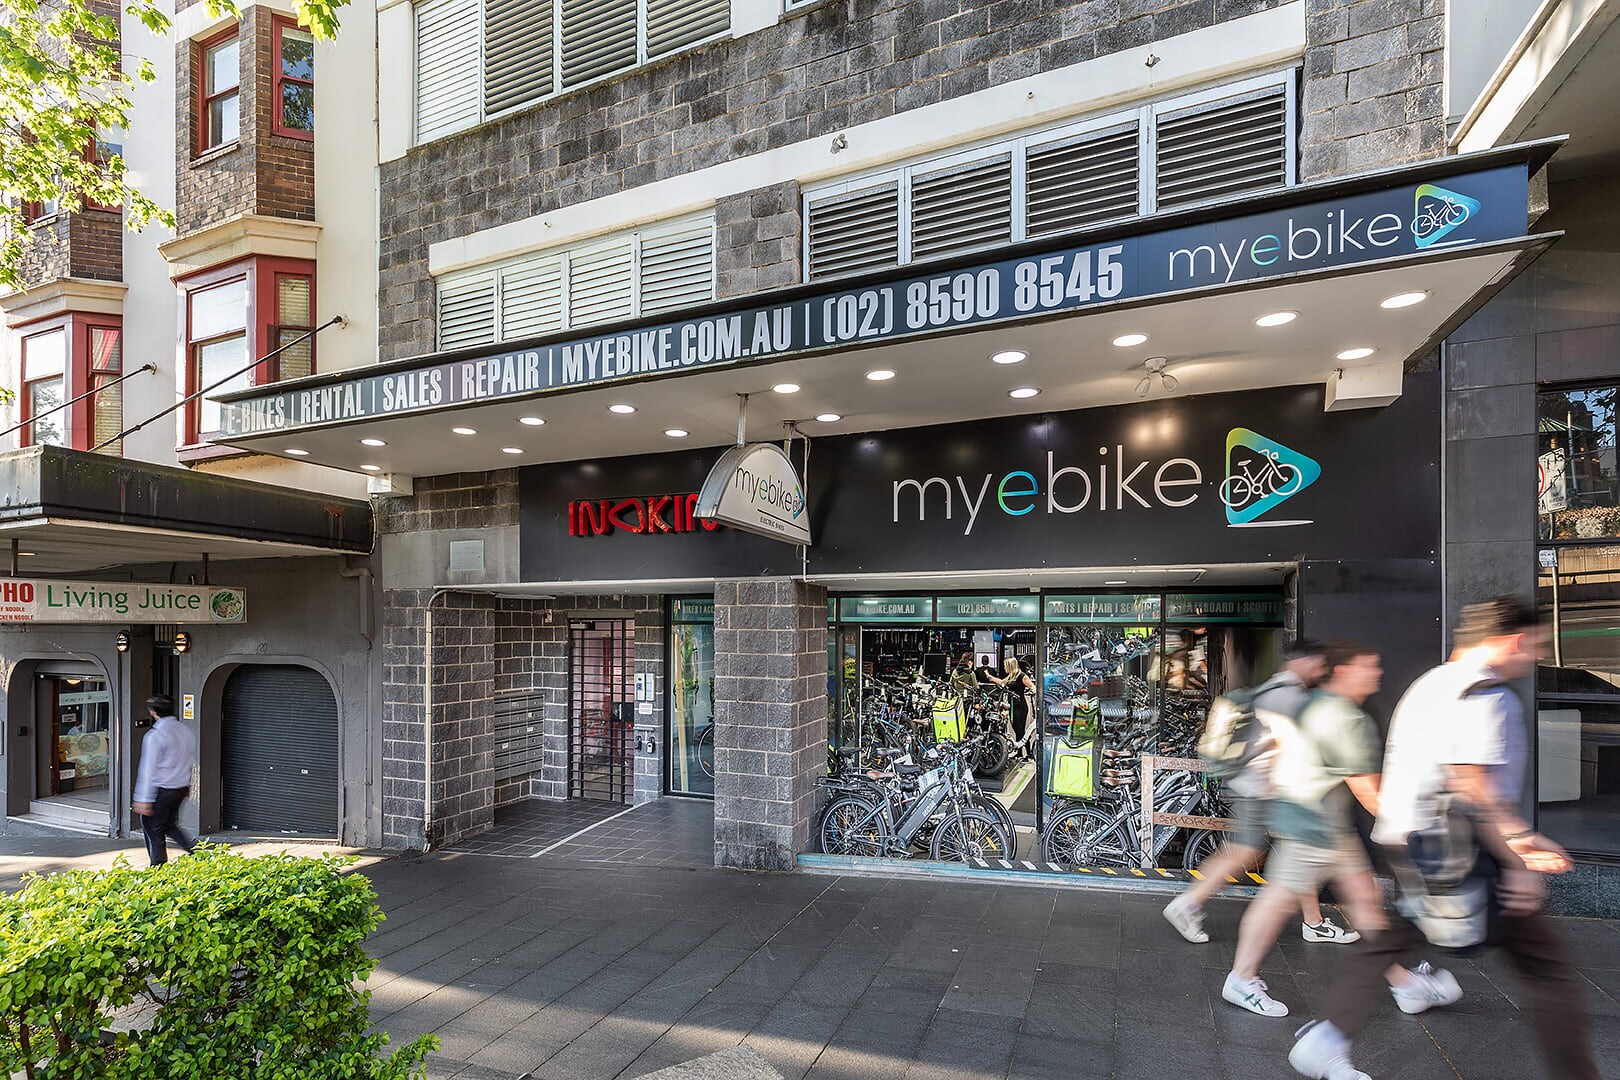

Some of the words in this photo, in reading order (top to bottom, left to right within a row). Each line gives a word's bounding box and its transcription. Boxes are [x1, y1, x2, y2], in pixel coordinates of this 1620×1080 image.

[1169, 209, 1402, 283] myebike
[226, 395, 285, 434] E-BIKES
[300, 383, 365, 424] RENTAL
[382, 368, 442, 412] SALES
[462, 348, 539, 400] REPAIR
[562, 307, 792, 384] MYEBIKE.COM.AU
[823, 287, 893, 343] (02)
[906, 268, 1000, 329] 8590
[1014, 244, 1123, 312] 8545
[735, 467, 793, 512] myebike
[893, 444, 1202, 536] myebike
[0, 583, 34, 603] HO
[48, 585, 128, 614] Living
[138, 588, 201, 609] Juice
[1083, 602, 1113, 613] REPAIR
[1243, 601, 1281, 613] SCOOTE
